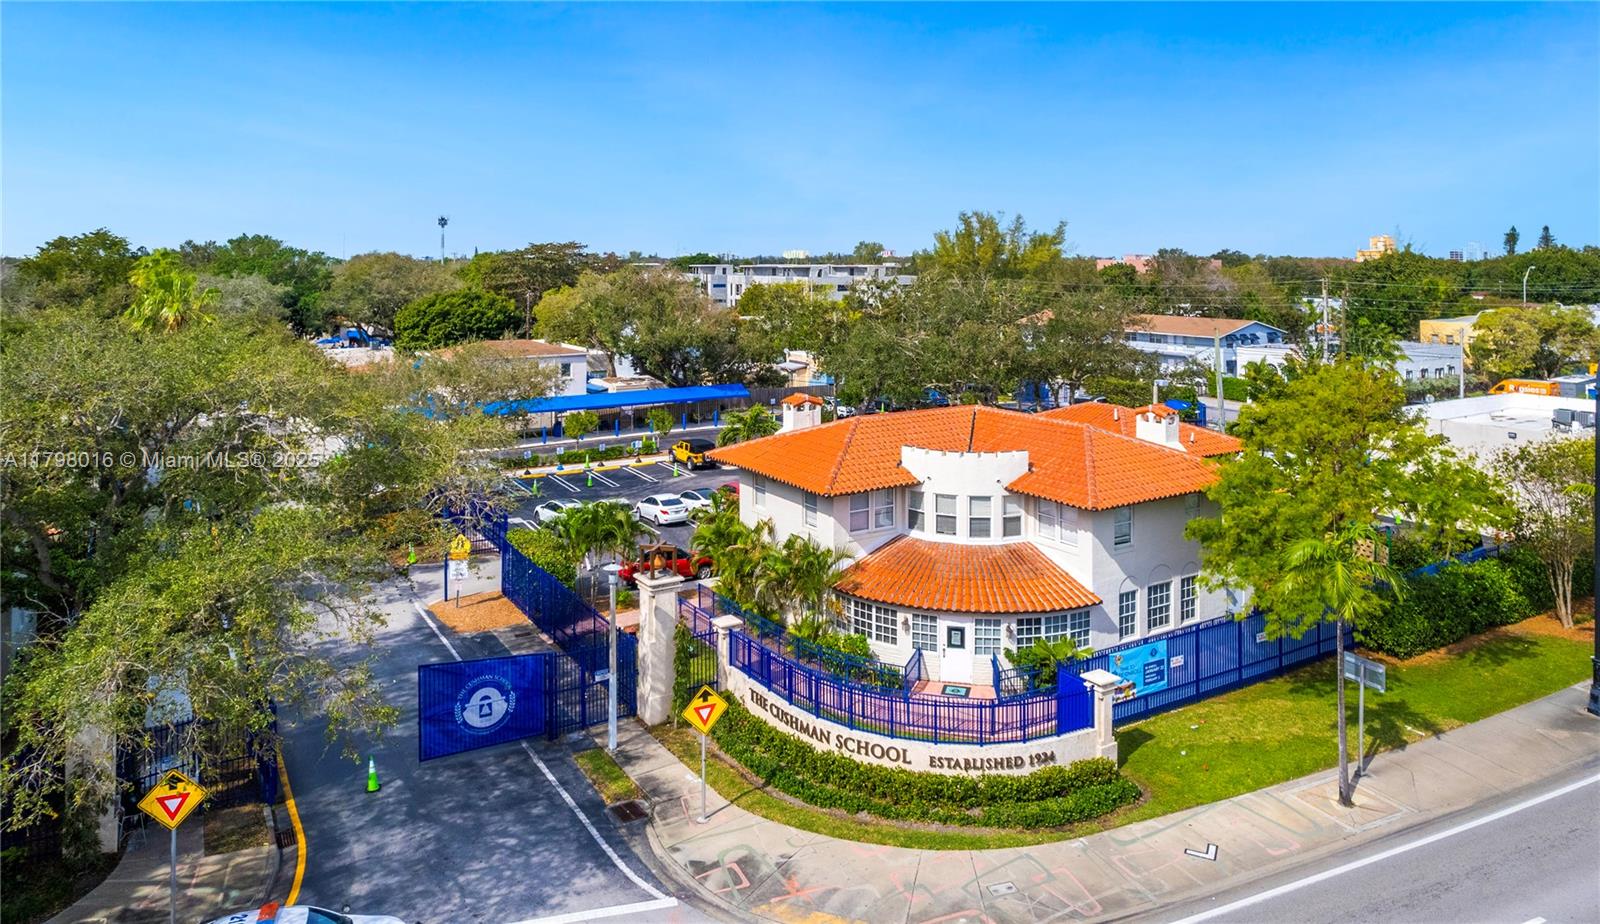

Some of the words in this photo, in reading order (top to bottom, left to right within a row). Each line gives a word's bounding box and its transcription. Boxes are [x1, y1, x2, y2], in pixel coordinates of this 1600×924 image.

[749, 687, 769, 713] THE
[769, 702, 831, 745] CUSHMAN
[835, 734, 912, 765] SCHOOL
[929, 755, 1025, 772] ESTABLISHED
